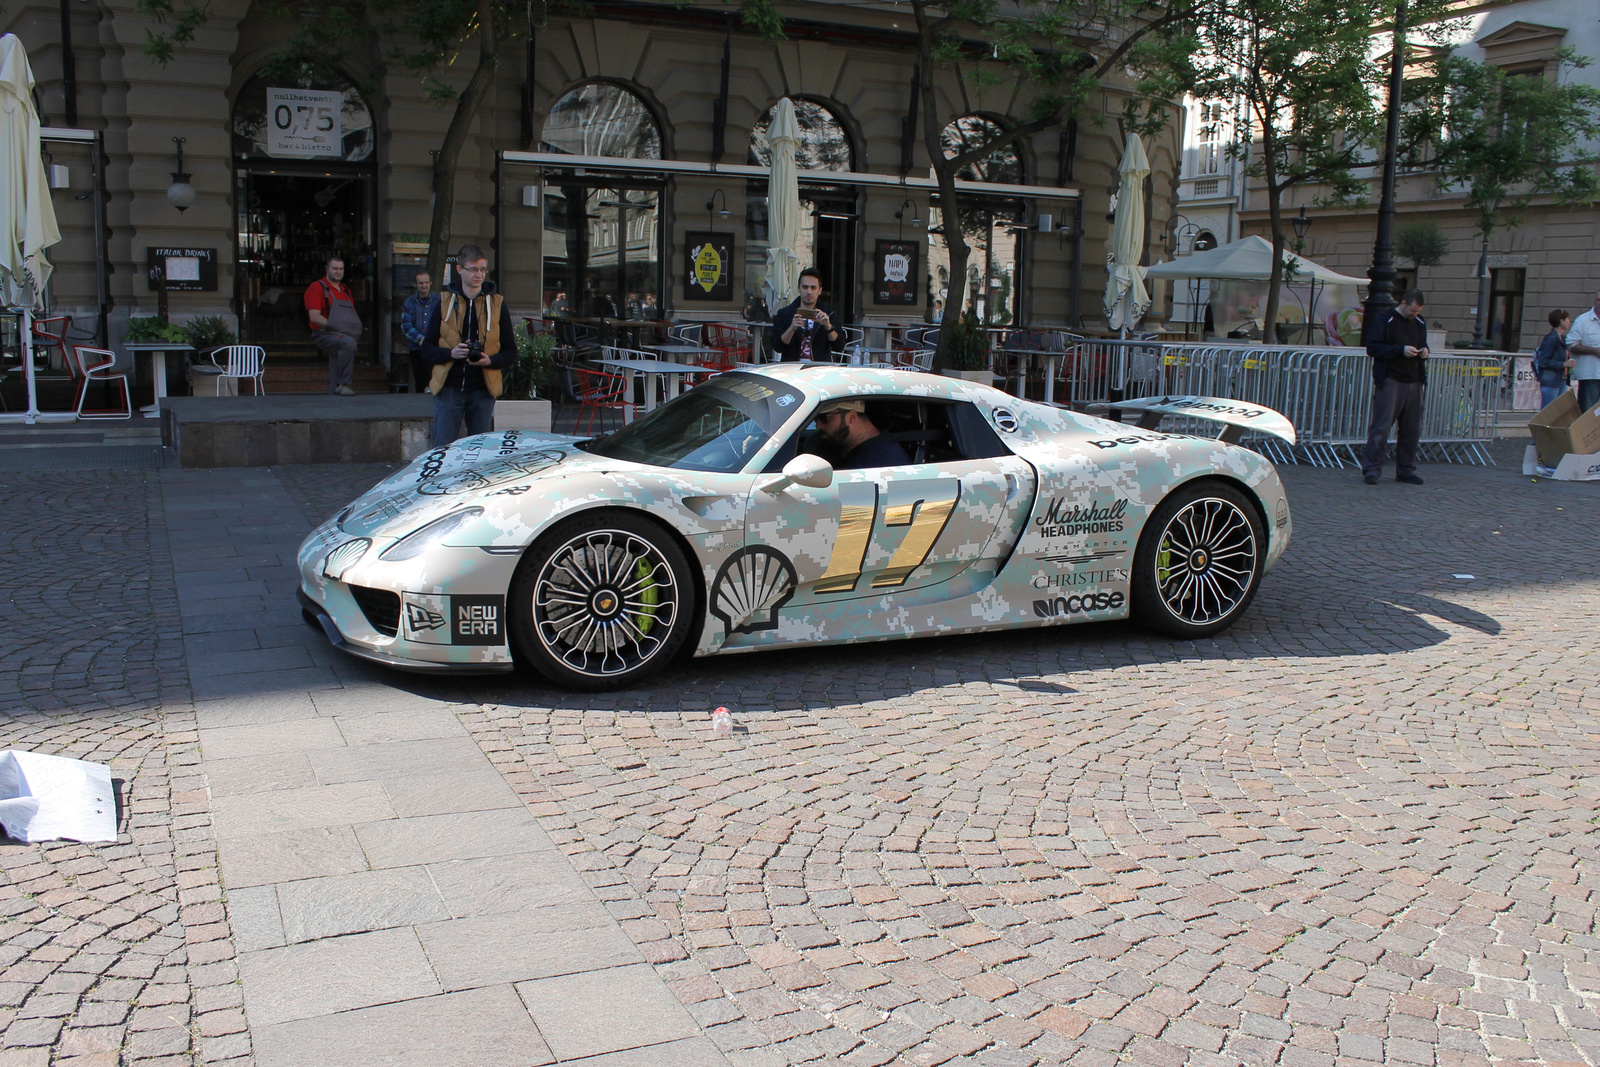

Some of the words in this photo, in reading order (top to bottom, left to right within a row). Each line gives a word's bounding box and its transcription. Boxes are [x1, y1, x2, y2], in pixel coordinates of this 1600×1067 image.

[275, 104, 334, 134] 0,75
[1035, 497, 1128, 526] Marshall
[813, 477, 962, 594] 17
[1041, 521, 1124, 538] HEADPHONES
[1033, 568, 1129, 590] CHRISTIE'S
[458, 605, 498, 620] NEW
[1048, 591, 1125, 618] incase
[459, 621, 498, 635] ERA
